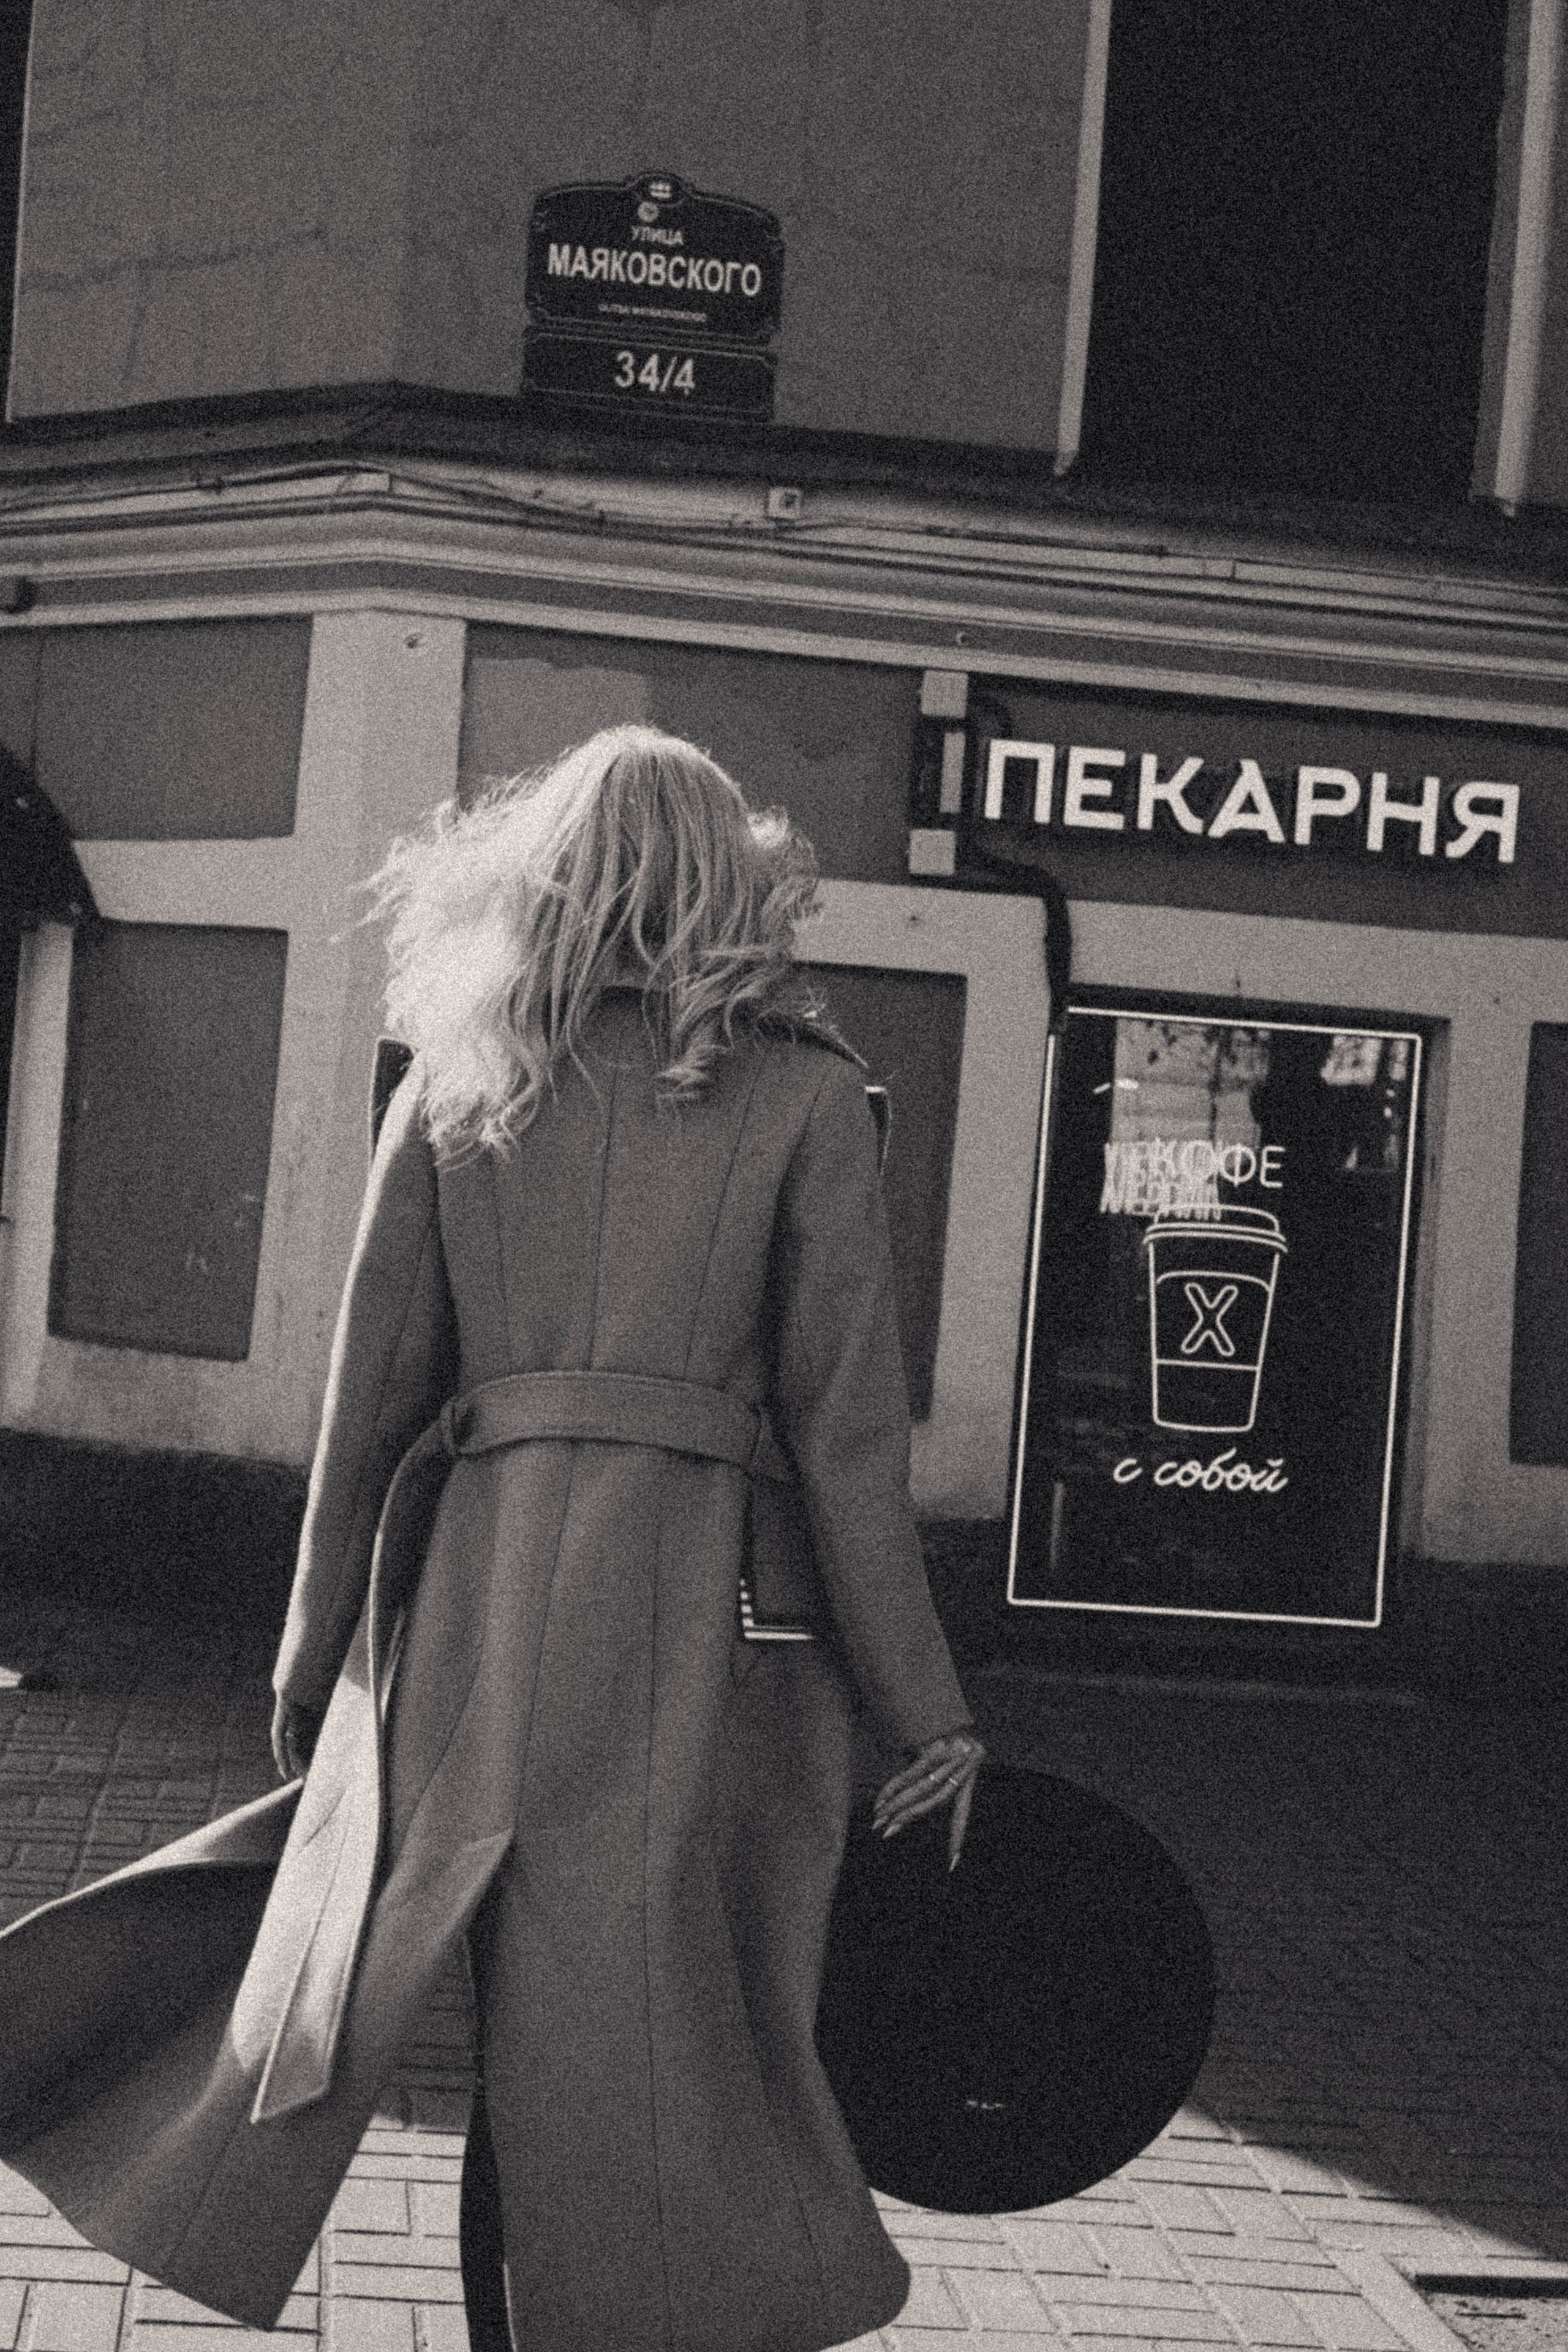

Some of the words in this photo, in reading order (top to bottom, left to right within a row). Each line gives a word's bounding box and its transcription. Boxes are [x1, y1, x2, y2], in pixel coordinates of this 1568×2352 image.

[548, 243, 761, 296] МАЯКОВСКОГО
[614, 350, 696, 395] 34/4
[984, 738, 1520, 864] ПЕКАРНЯ
[1113, 1458, 1144, 1483] с
[1153, 1447, 1289, 1493] собой
